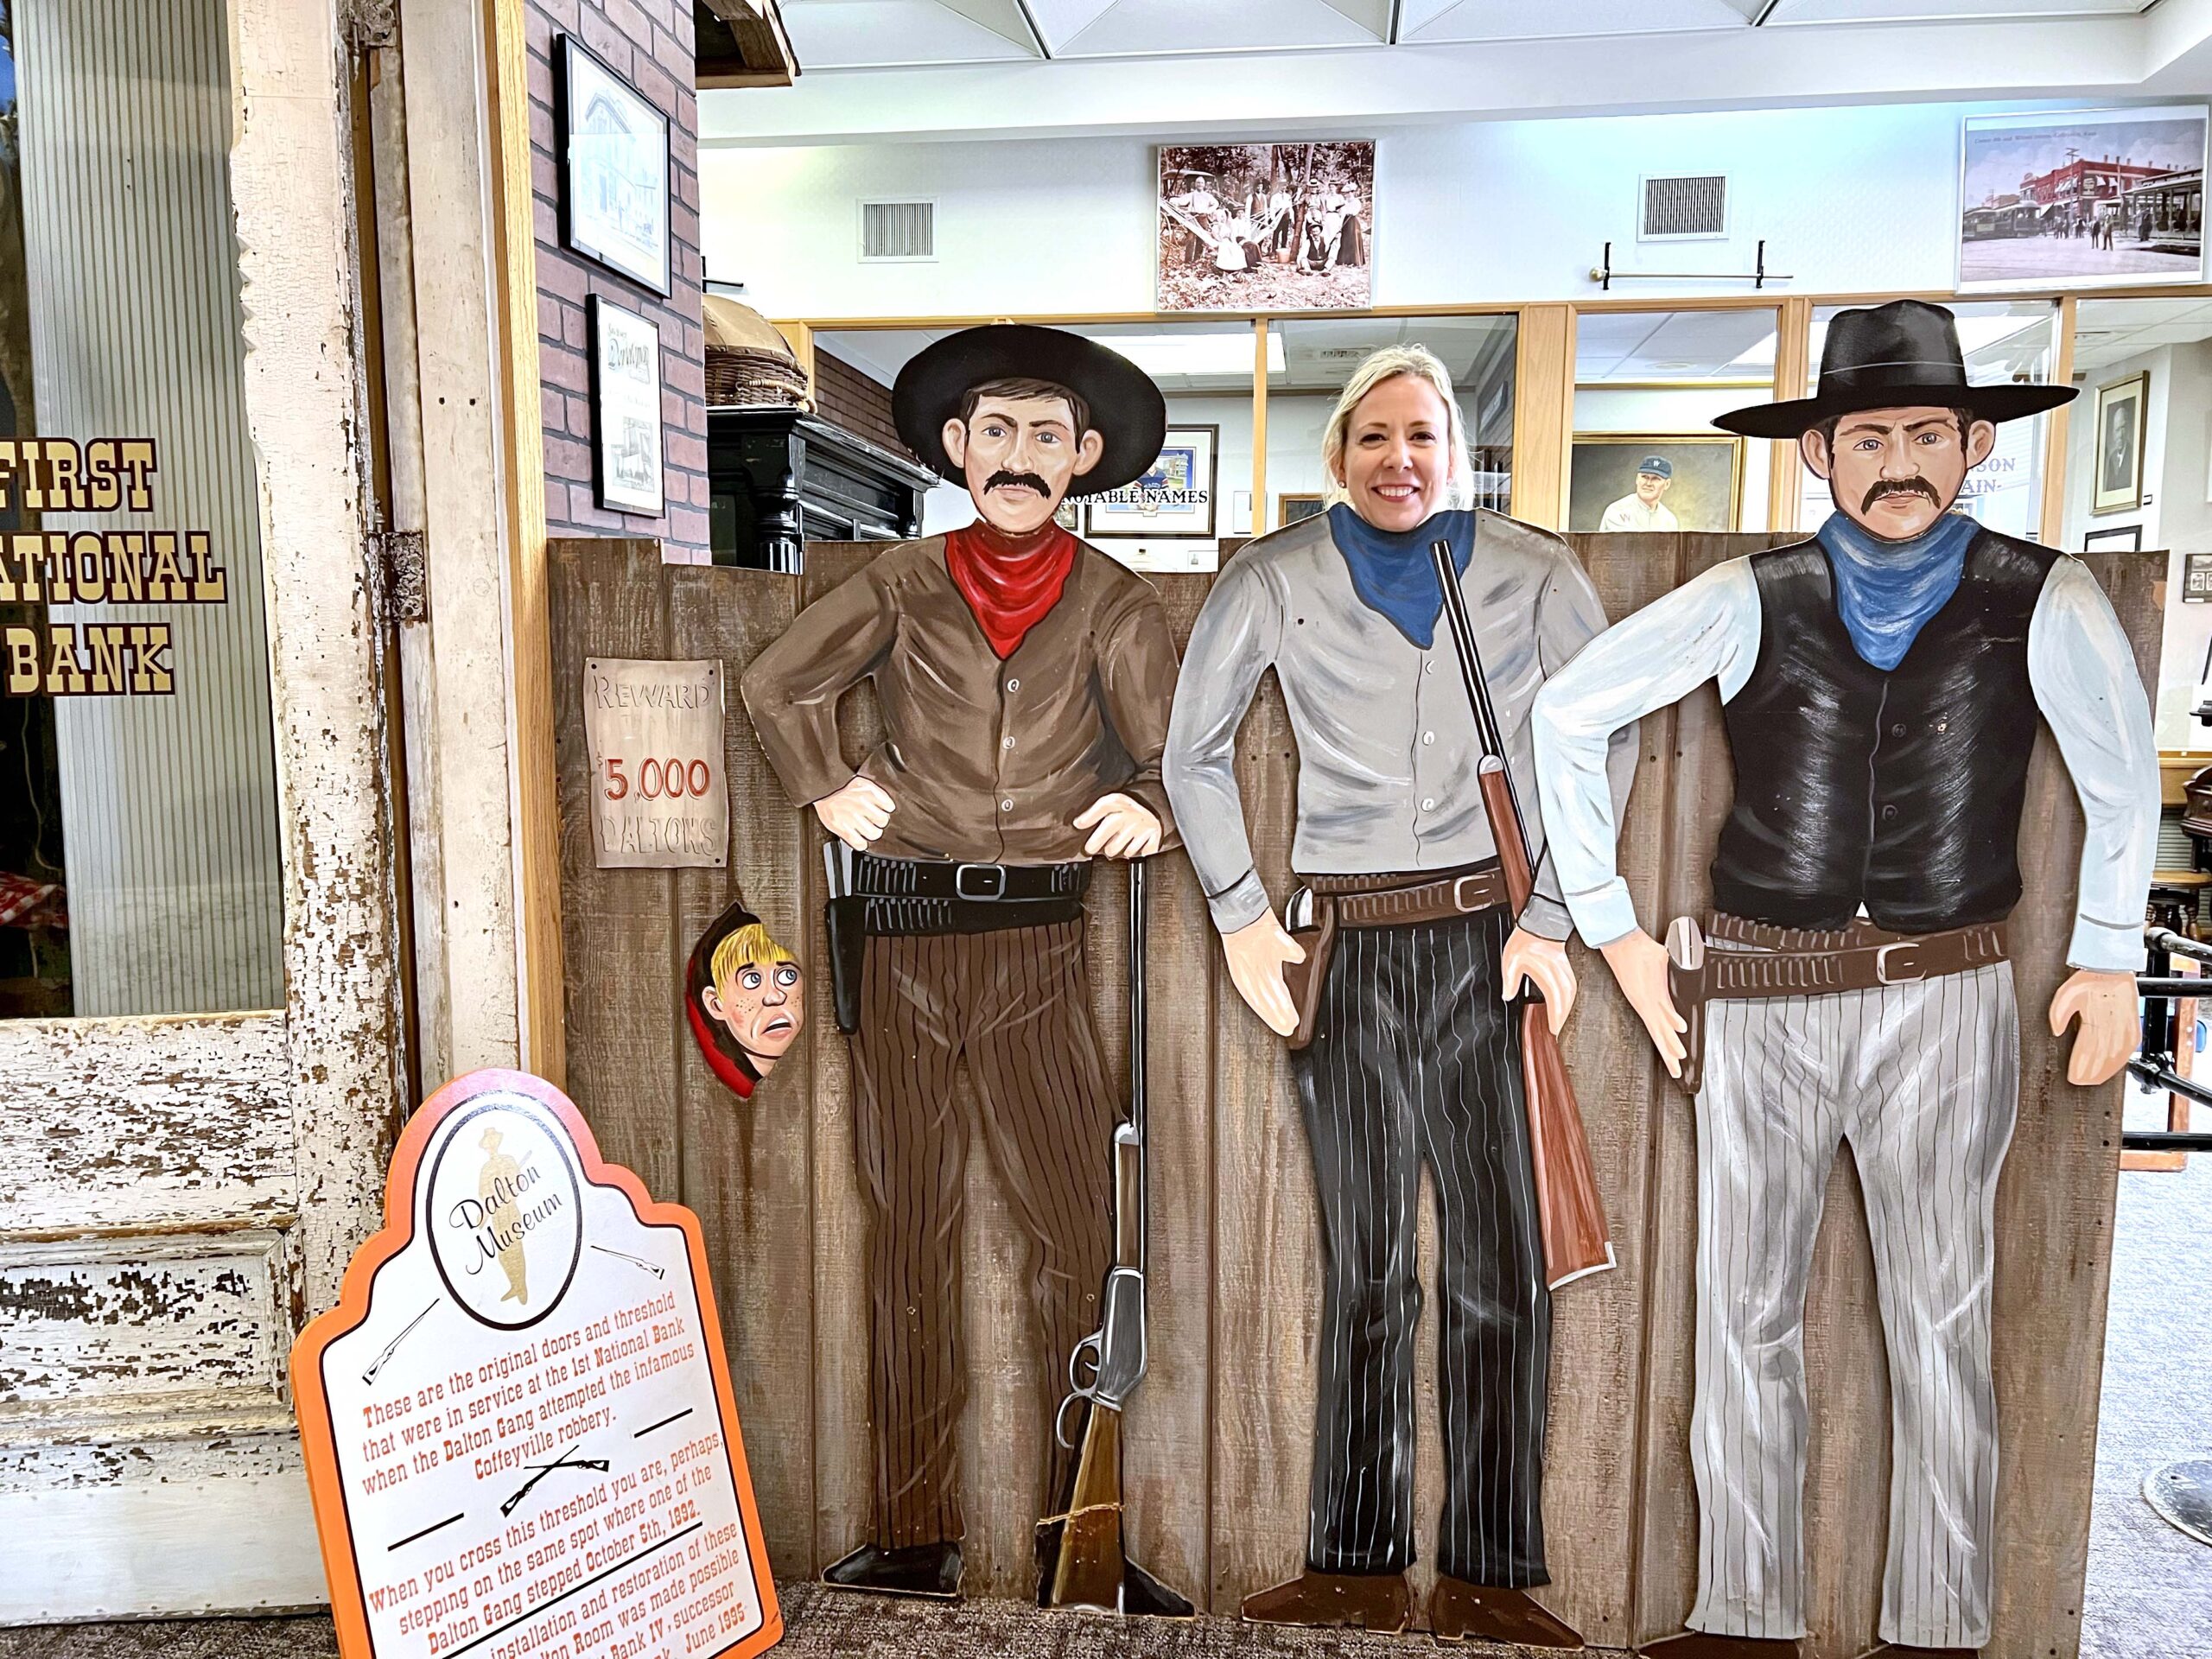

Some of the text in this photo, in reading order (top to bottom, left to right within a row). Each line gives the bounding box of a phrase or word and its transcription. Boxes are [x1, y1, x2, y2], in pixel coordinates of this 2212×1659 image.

[0, 437, 157, 512] FIRST
[1146, 490, 1208, 504] NAMES
[4, 622, 175, 696] BANK
[594, 675, 710, 709] REWARD
[600, 817, 716, 856] DALTONS
[449, 1166, 541, 1230] Dalton
[466, 1193, 563, 1275] Museum
[363, 1291, 676, 1428] These are the original doors and threshold
[363, 1316, 685, 1462] that were in service at the 1st National Bank
[362, 1342, 695, 1496] when the Dalton Gang attempted the infamous
[474, 1406, 617, 1480] Coffeyville robbery.
[369, 1432, 724, 1614] When you cross this threshold you are, perhaps,
[399, 1465, 712, 1636] stepping on the same spot where one of the
[428, 1498, 701, 1656] Dalton Gang stepped October 5th, 1892.
[573, 1620, 613, 1655] Room
[618, 1600, 646, 1629] was
[650, 1580, 686, 1611] made
[690, 1548, 740, 1593] possible
[581, 1588, 609, 1620] and
[612, 1550, 685, 1604] restoration
[688, 1538, 701, 1560] of
[703, 1522, 737, 1552] these
[610, 1631, 646, 1659] Bank
[673, 1581, 734, 1630] successor
[685, 1624, 715, 1654] June
